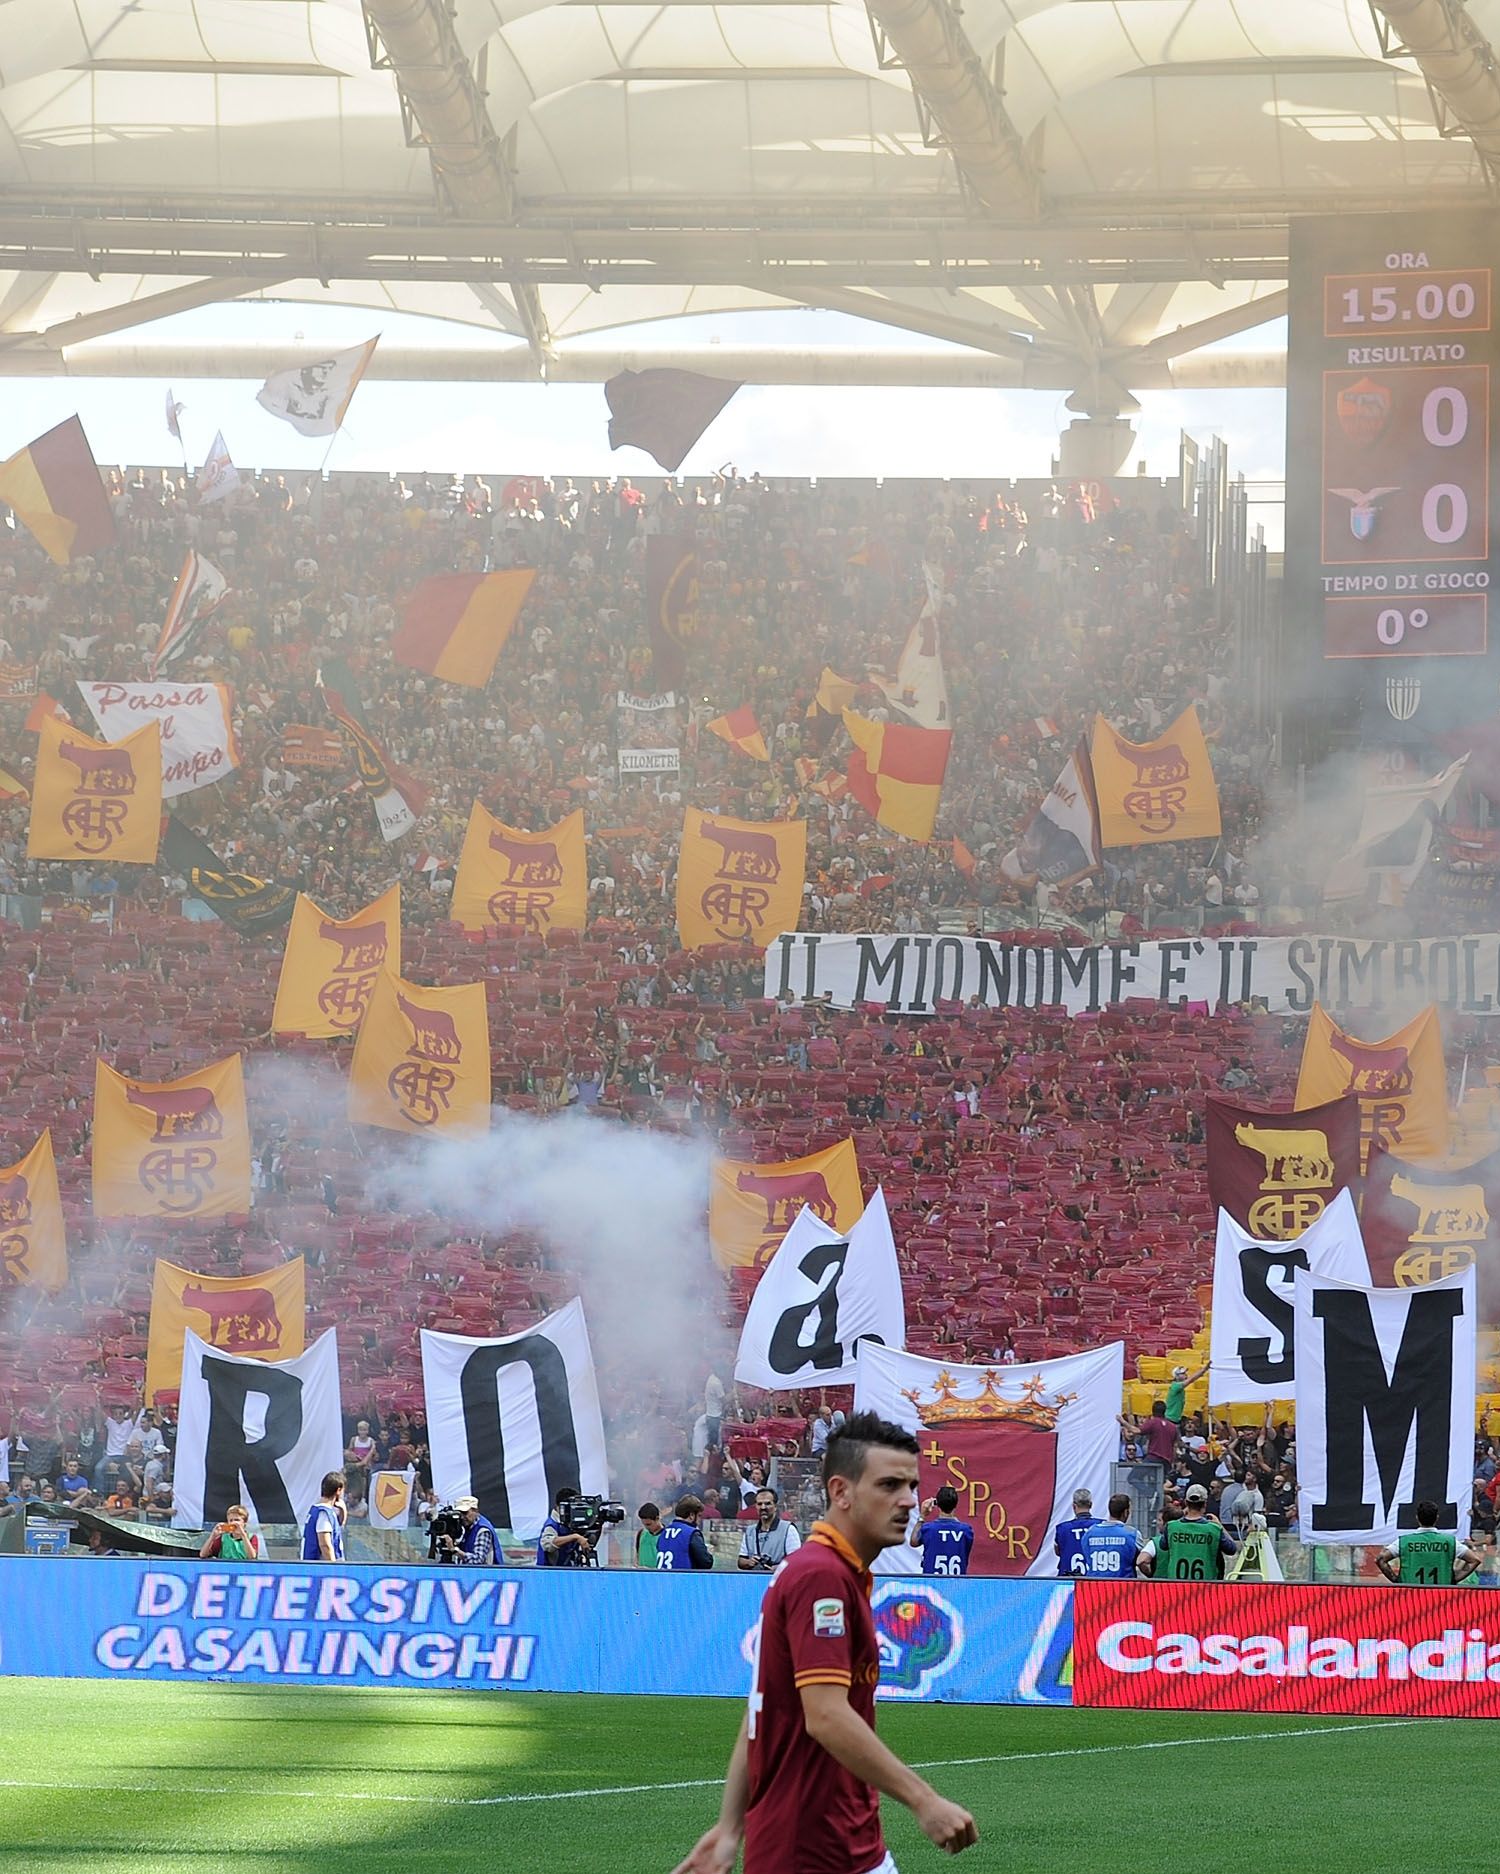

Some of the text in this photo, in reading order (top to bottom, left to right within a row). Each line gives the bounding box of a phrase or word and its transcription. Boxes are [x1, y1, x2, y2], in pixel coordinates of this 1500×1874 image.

[1385, 253, 1429, 269] ORA
[1342, 283, 1475, 323] 15.00
[1348, 344, 1465, 364] RISULTATO
[1422, 386, 1468, 447] 0
[1422, 483, 1468, 544] 0
[1321, 572, 1489, 592] TEMPO DI GIOCO
[1377, 608, 1428, 645] 0°
[1386, 677, 1421, 687] Italia
[92, 684, 208, 714] Passa
[621, 753, 679, 770] KILOMETRI
[779, 935, 832, 1001] IL
[853, 938, 963, 1010] MIO
[976, 940, 1141, 1015] NOME
[1216, 942, 1268, 1007] IL
[665, 1528, 681, 1539] TV
[938, 1530, 964, 1542] TV
[1172, 1532, 1213, 1545] SERVIZIO
[1407, 1541, 1449, 1553] SERVIZIO
[934, 1555, 961, 1575] 56
[1090, 1551, 1120, 1572] 199
[1176, 1559, 1204, 1580] 06
[1415, 1567, 1438, 1585] 11
[137, 1572, 520, 1626] DETERSIVI
[97, 1624, 537, 1680] CASALINGHI
